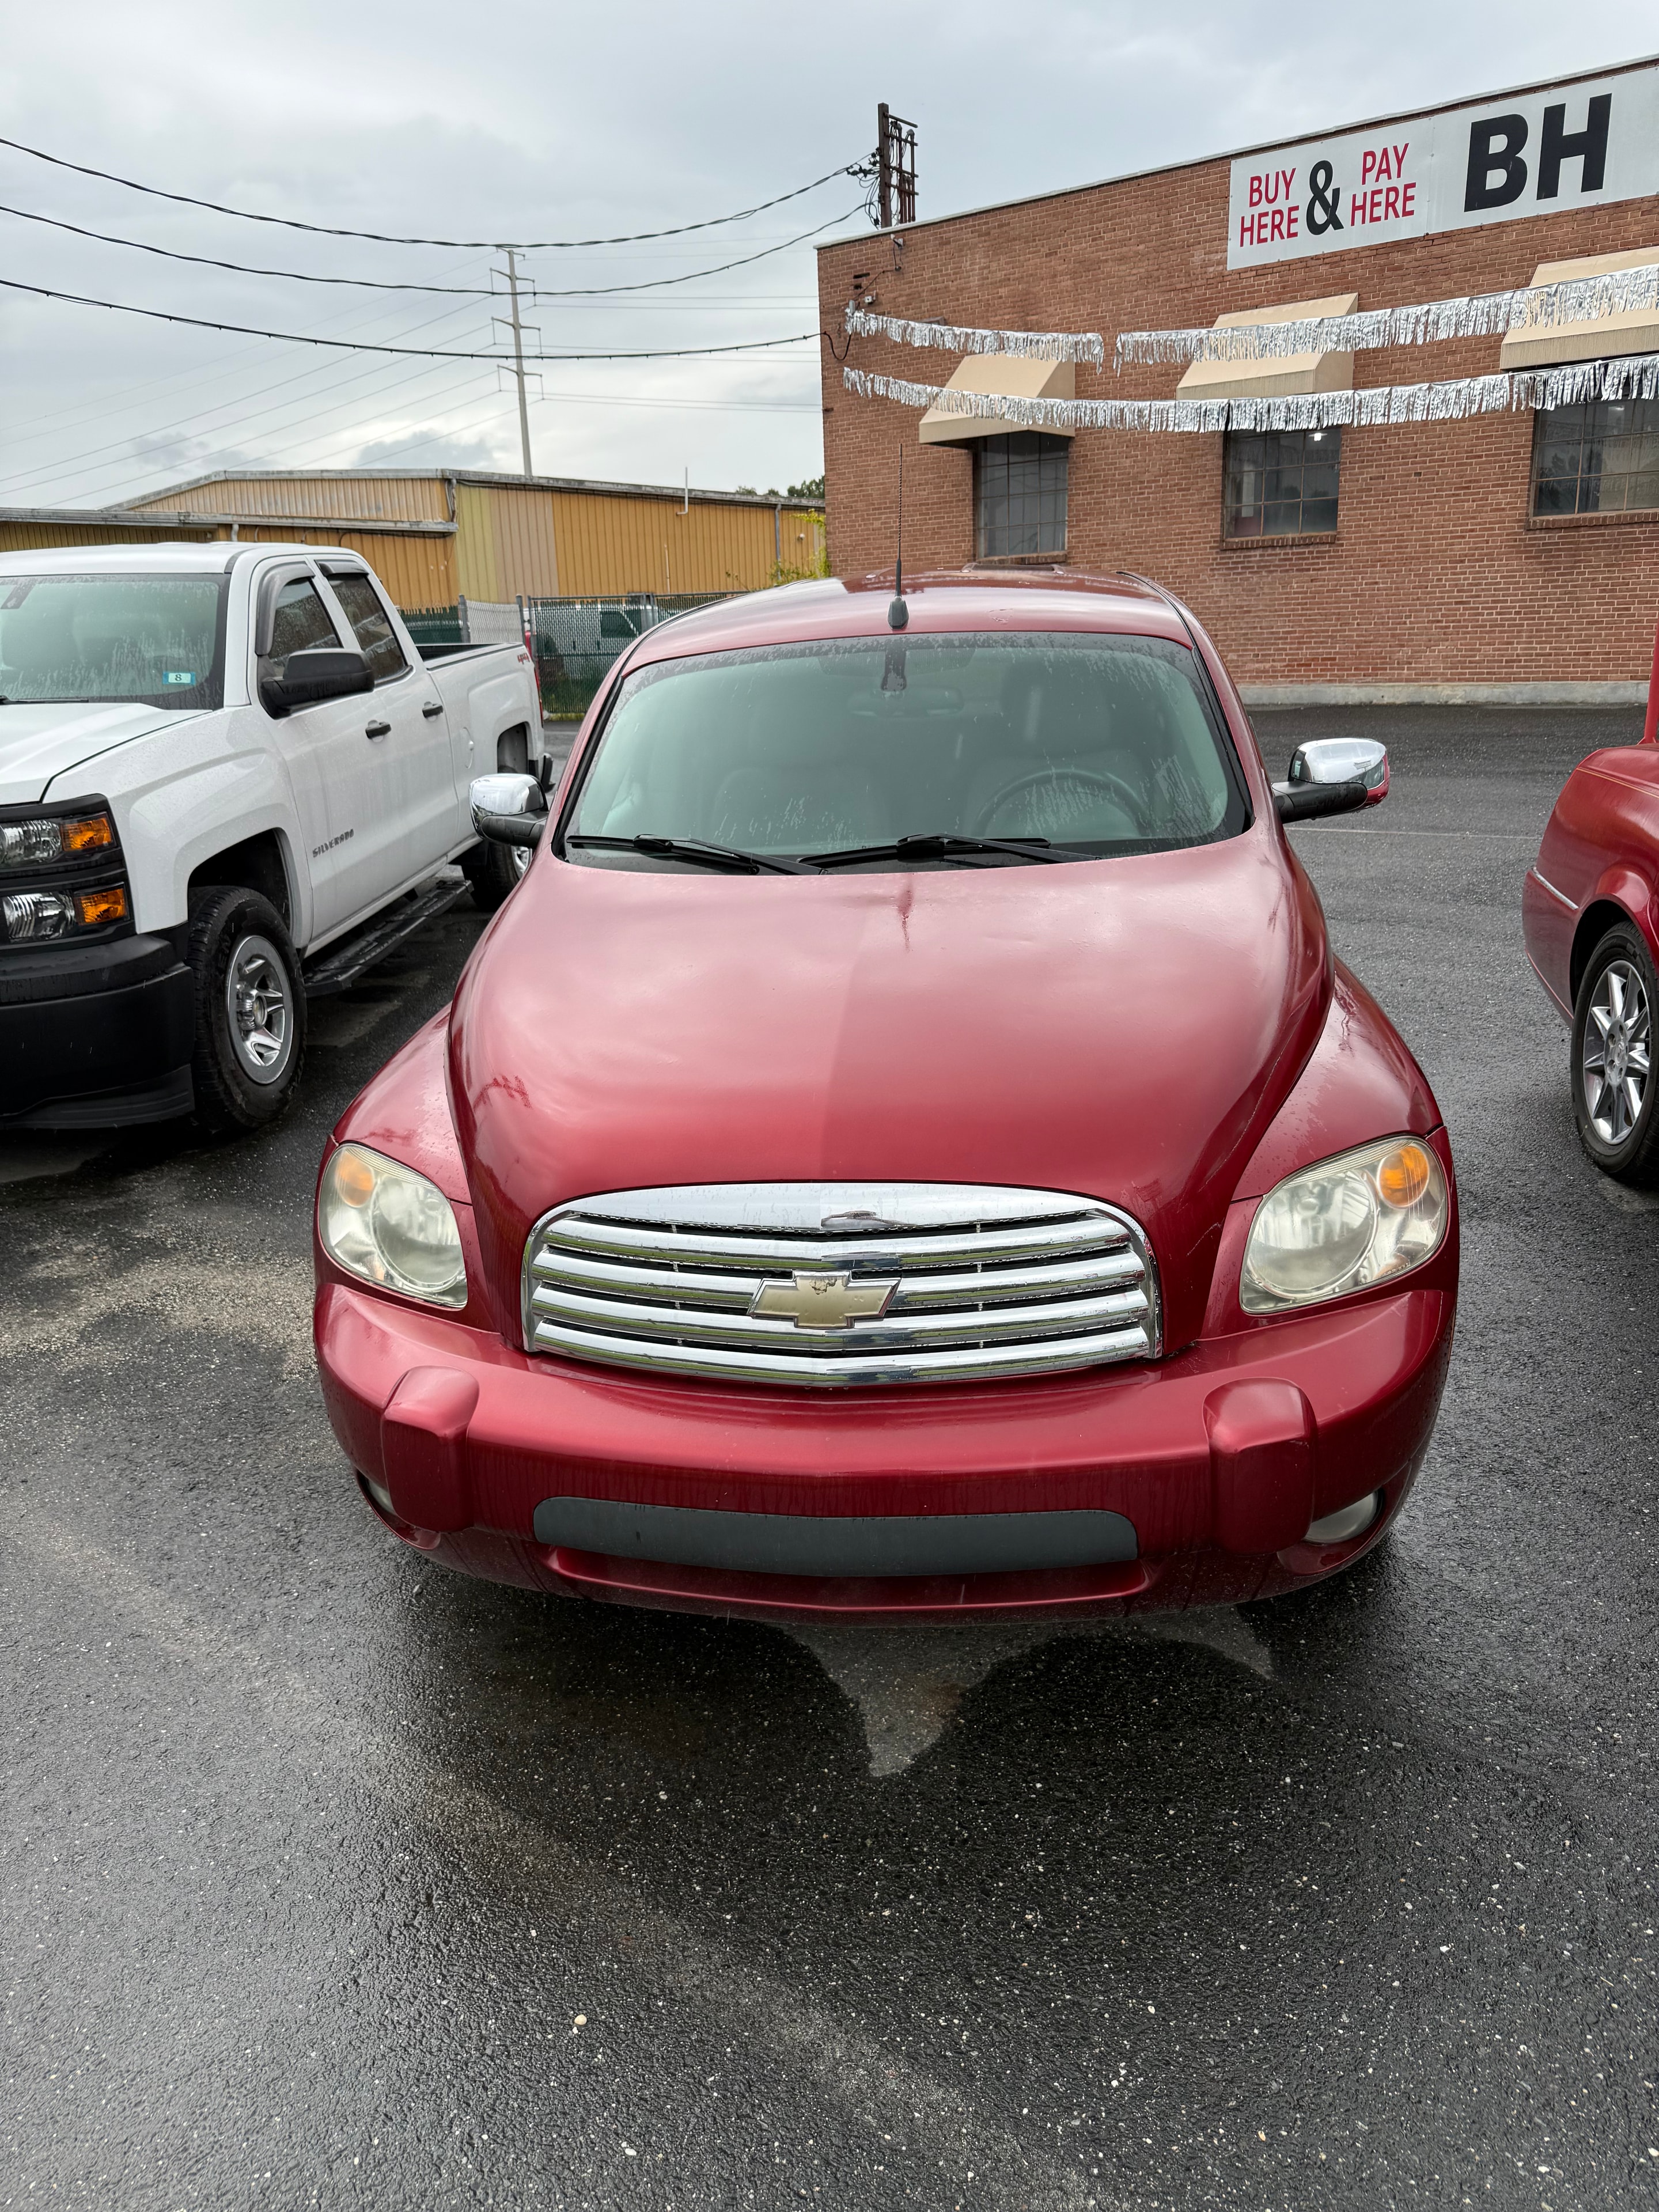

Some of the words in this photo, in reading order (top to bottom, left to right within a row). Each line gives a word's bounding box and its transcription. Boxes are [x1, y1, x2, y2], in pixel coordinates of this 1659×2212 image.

[1362, 142, 1410, 185] PAY
[1464, 93, 1612, 213] BH
[1249, 168, 1296, 208] BUY
[1306, 160, 1344, 236] &
[1350, 182, 1417, 227] HERE
[1240, 205, 1300, 248] HERE
[312, 828, 354, 858] SILVERADO
